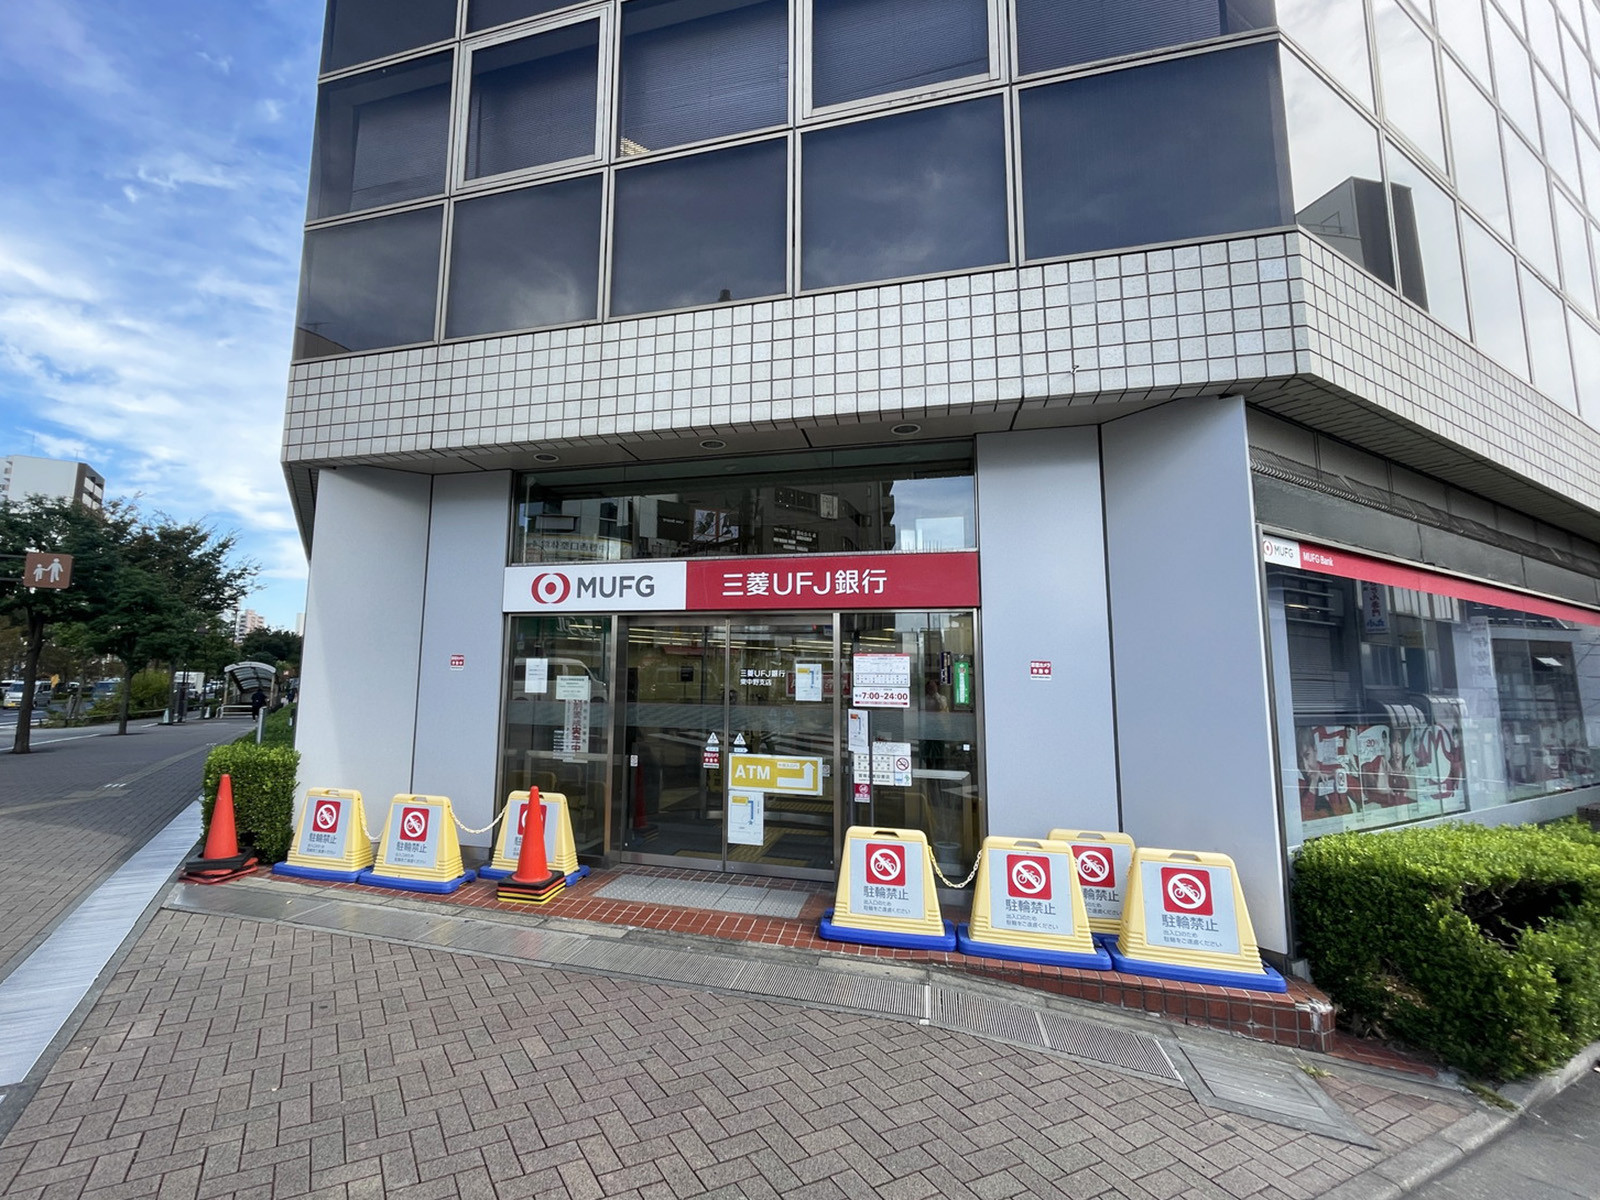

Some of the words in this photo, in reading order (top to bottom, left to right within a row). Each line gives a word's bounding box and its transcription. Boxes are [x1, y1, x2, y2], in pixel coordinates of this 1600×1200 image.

[1274, 544, 1294, 559] MUFG
[1302, 552, 1320, 564] MUFG
[1320, 555, 1334, 566] Bank
[577, 575, 655, 597] MUFG
[722, 569, 887, 597] 三菱UFJ銀行
[740, 669, 786, 678] 三菱UFJ銀行
[735, 764, 771, 780] ATM
[863, 885, 910, 901] 駐輪禁止
[1083, 888, 1120, 903] 輪禁止
[1005, 898, 1057, 915] 駐輪禁止
[1161, 914, 1220, 933] 駐輪禁止
